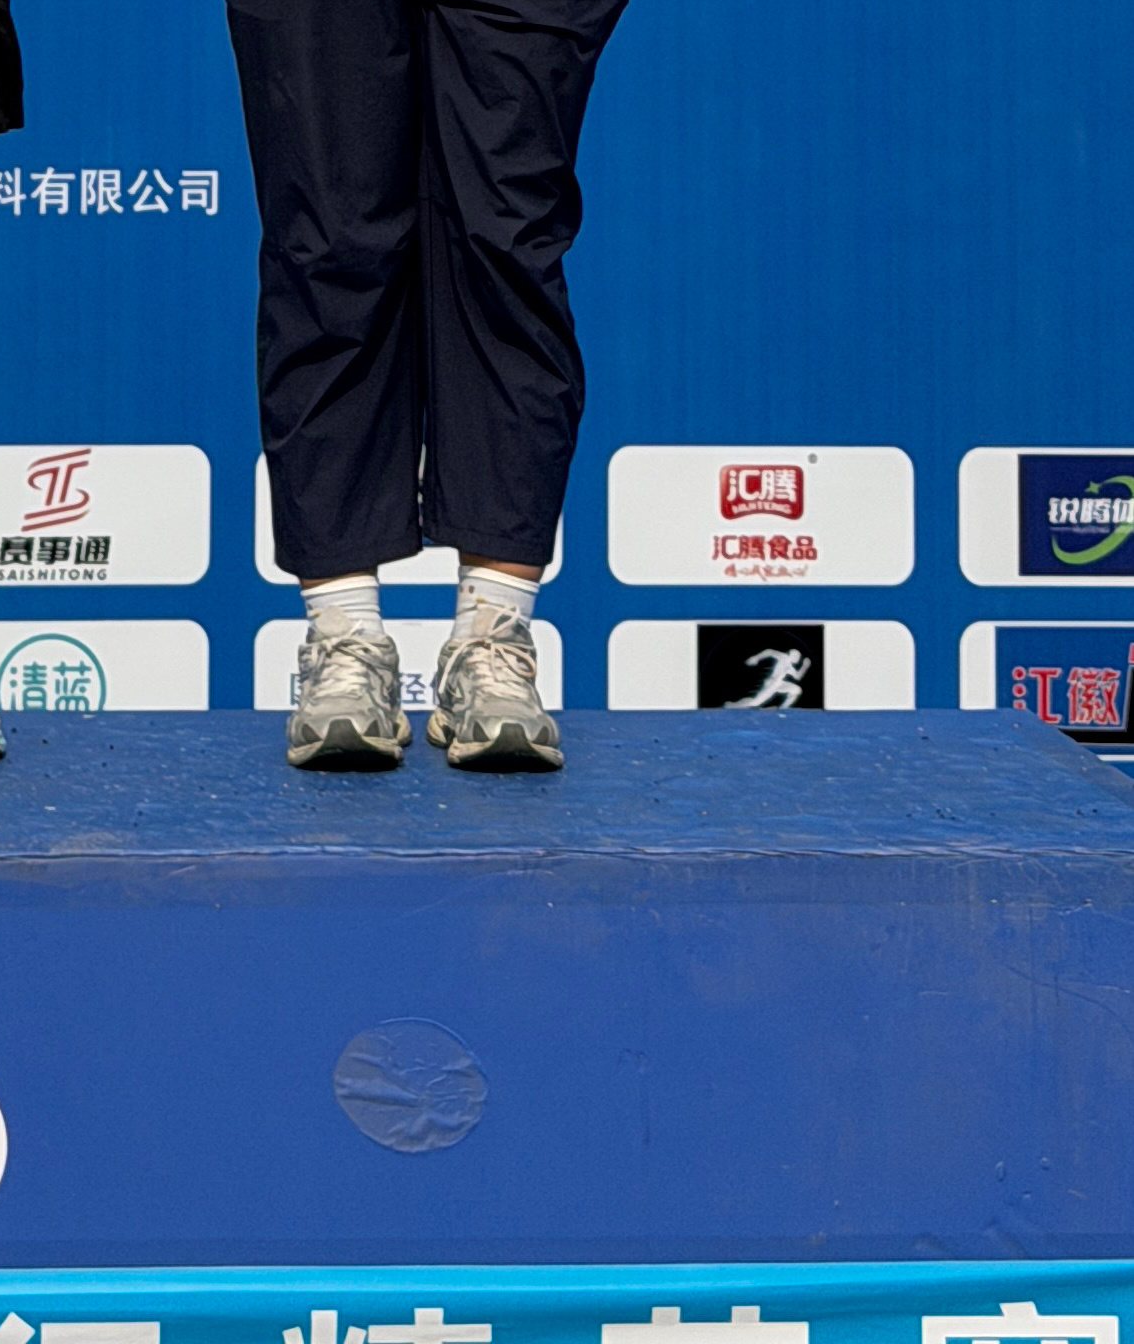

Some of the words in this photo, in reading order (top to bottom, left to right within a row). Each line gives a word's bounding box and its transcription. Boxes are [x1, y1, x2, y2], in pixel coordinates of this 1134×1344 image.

[727, 469, 798, 503] 汇腾
[712, 535, 818, 561] 汇腾食品
